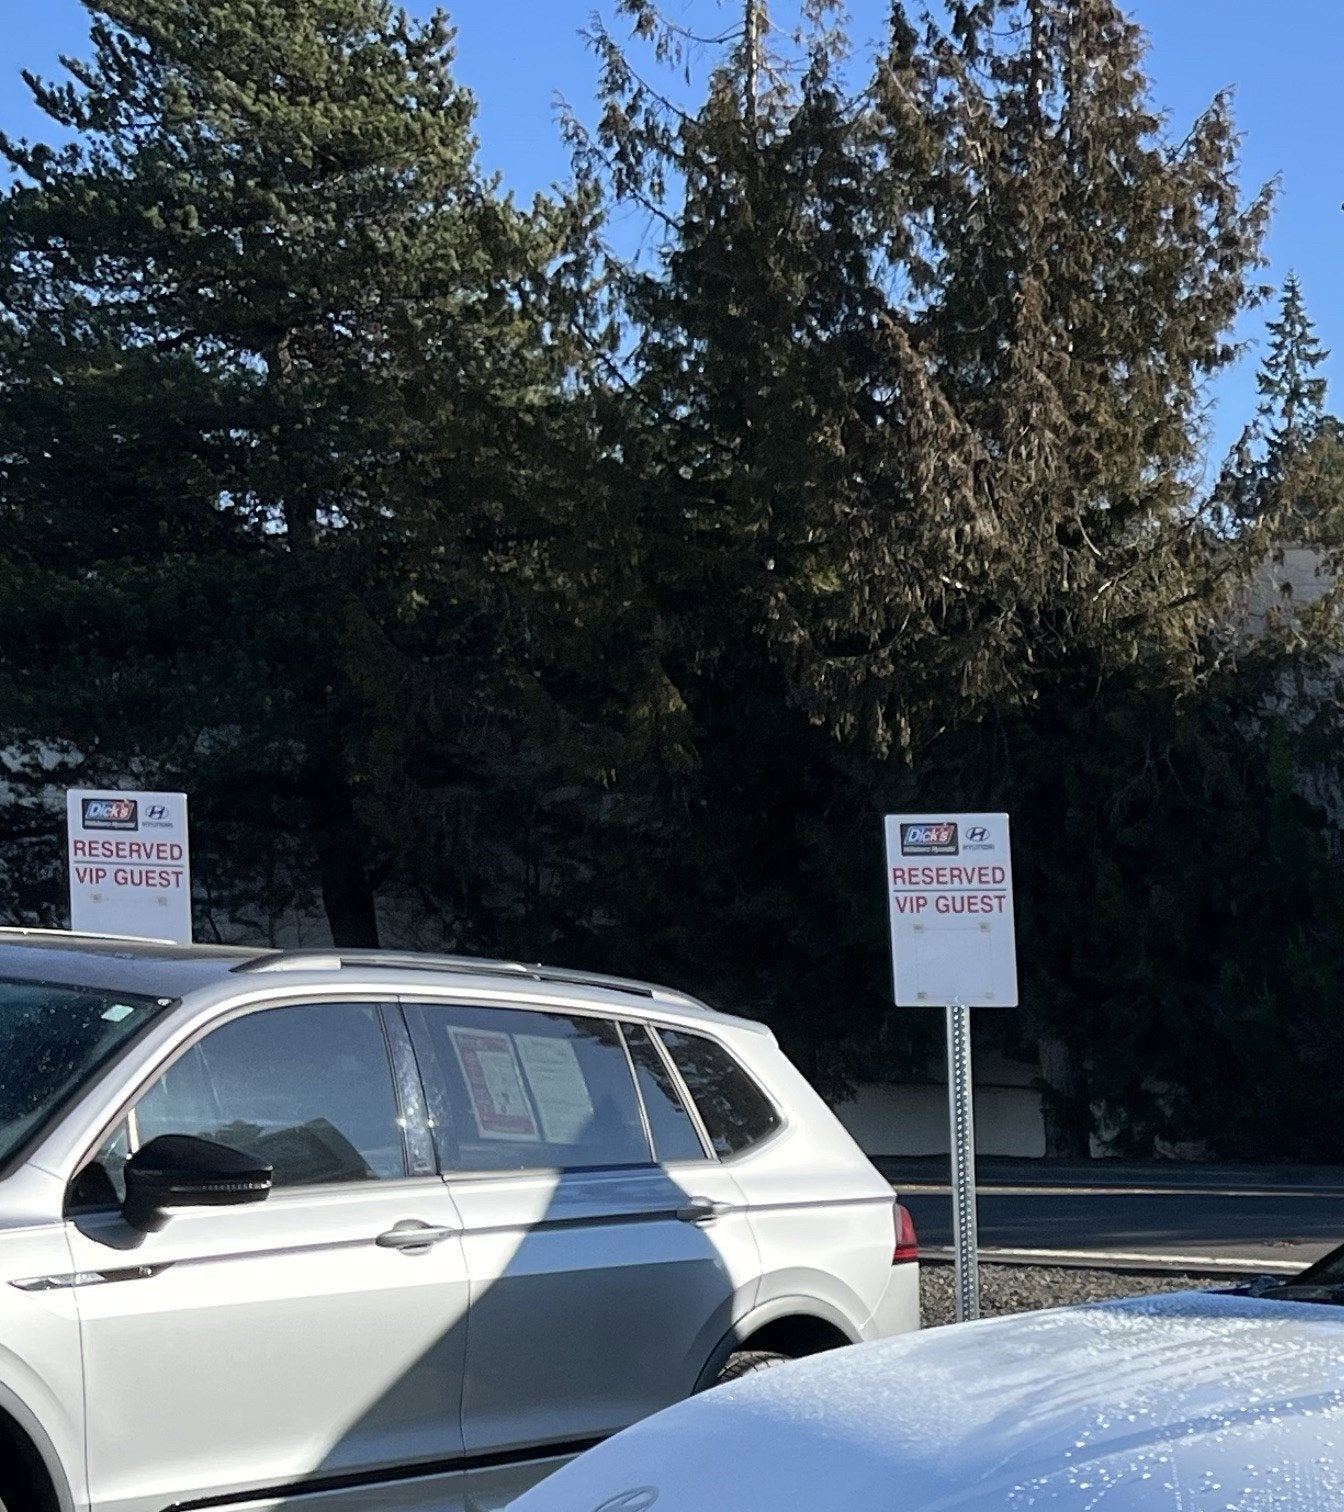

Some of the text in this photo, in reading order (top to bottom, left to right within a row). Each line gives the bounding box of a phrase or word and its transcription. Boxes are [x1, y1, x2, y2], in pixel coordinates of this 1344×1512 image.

[73, 839, 183, 861] RESERVED
[75, 867, 184, 888] VIP GUEST
[892, 866, 1006, 886] RESERVED
[895, 895, 1007, 914] VIP GUEST
